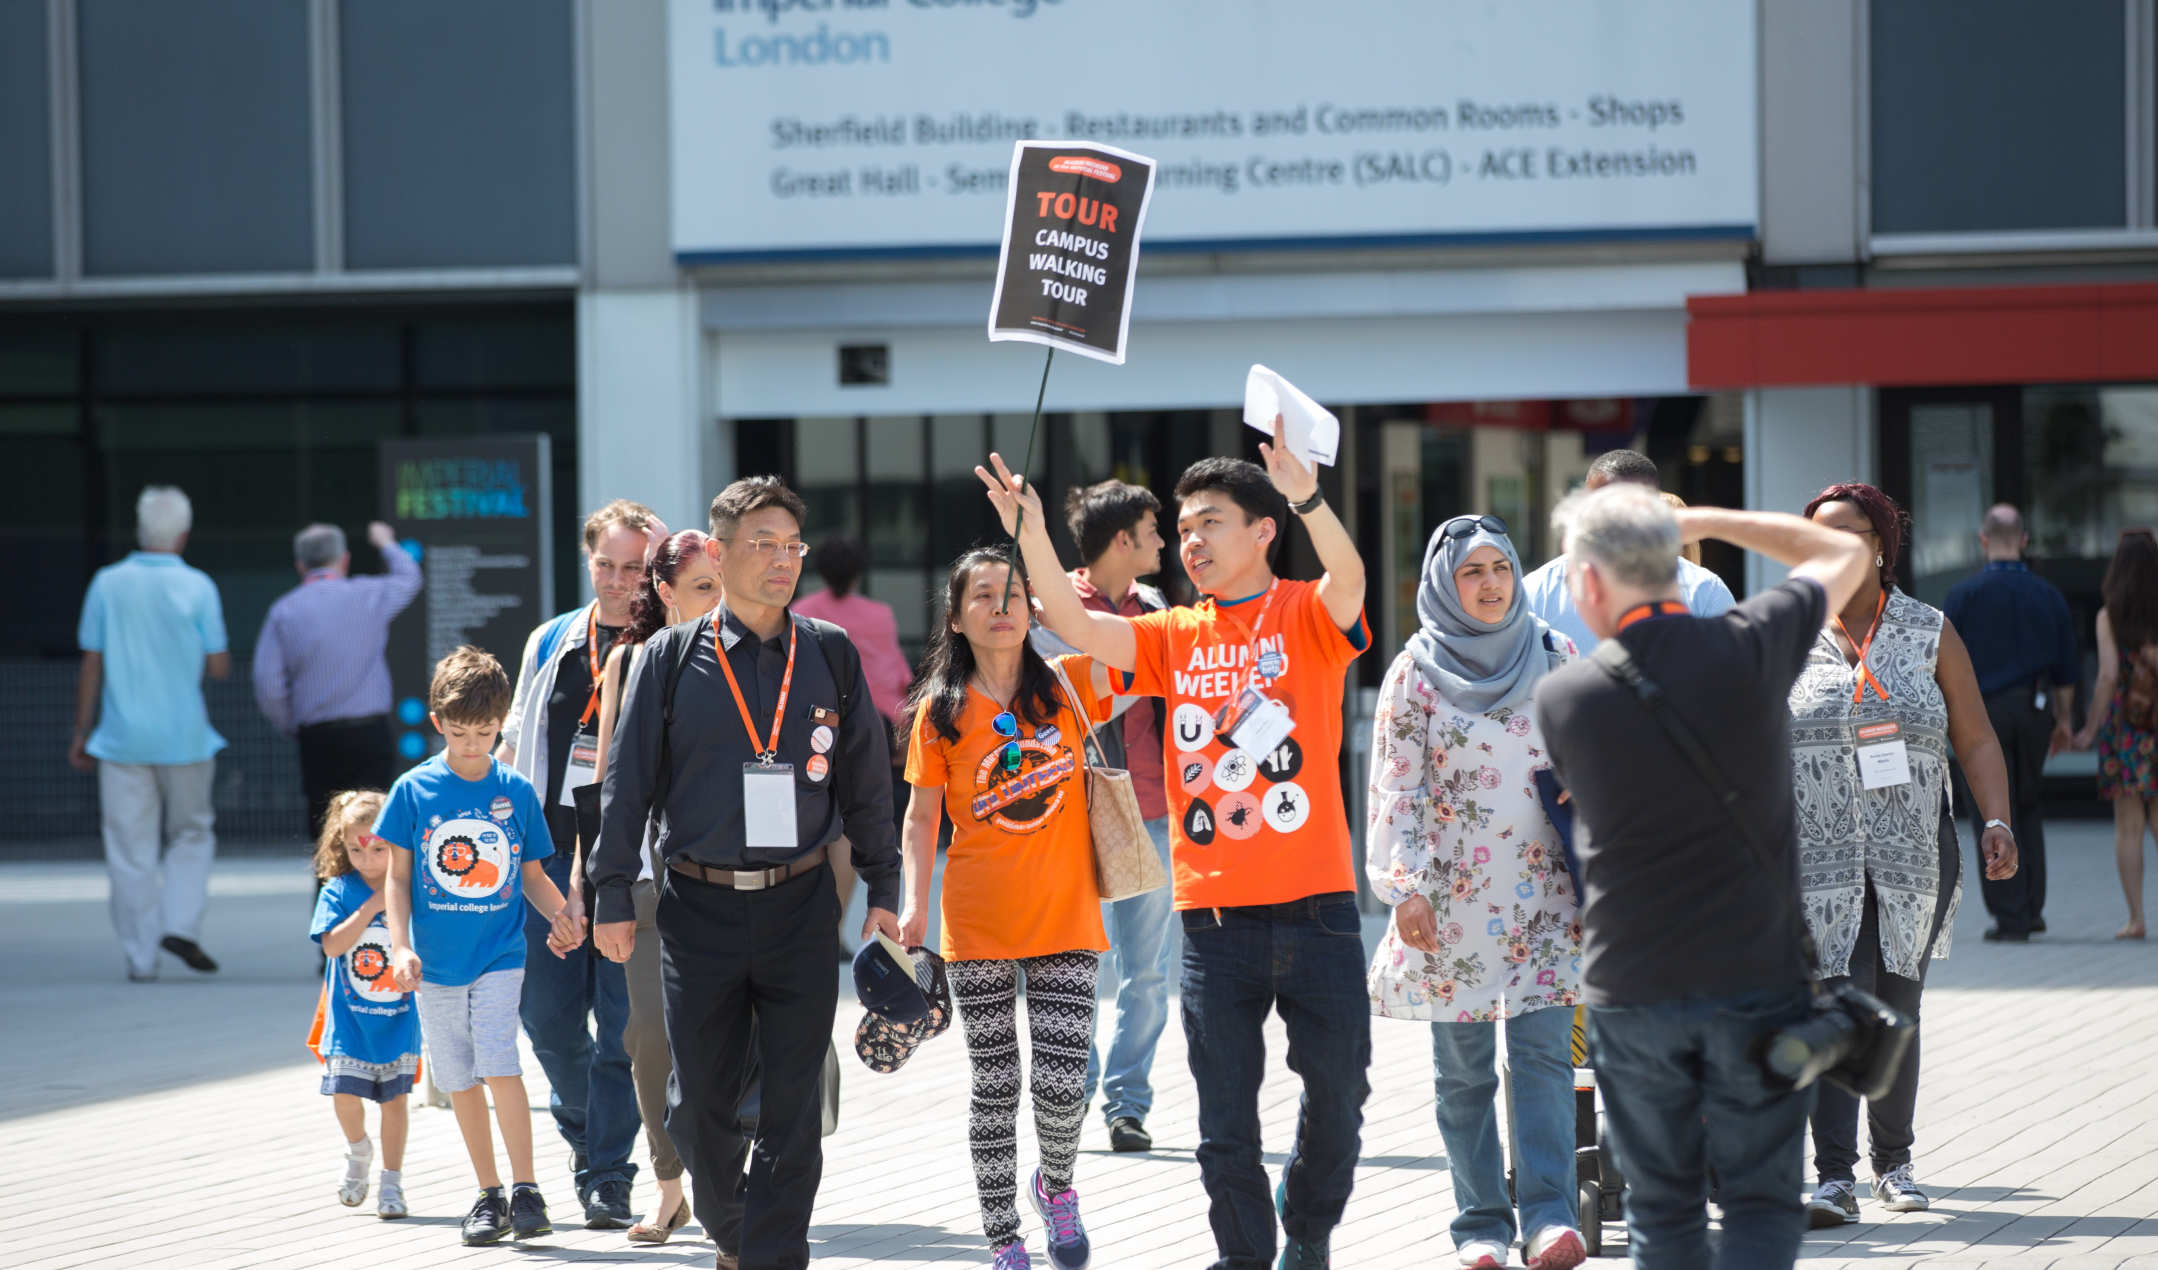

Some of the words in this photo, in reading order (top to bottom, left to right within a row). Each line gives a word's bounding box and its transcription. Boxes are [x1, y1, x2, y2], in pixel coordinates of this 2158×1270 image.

[713, 22, 890, 68] London
[770, 115, 906, 147] Sherfield
[913, 114, 1038, 144] Building
[1064, 108, 1243, 138] Restaurants
[1253, 104, 1308, 136] and
[1314, 102, 1449, 134] Common
[1457, 100, 1561, 131] Rooms
[1586, 95, 1685, 131] Shops
[770, 167, 851, 199] Great
[858, 164, 920, 196] Hall
[1246, 155, 1345, 188] Centre
[1352, 147, 1453, 188] (SALC)
[1478, 148, 1537, 182] ACE
[1546, 141, 1697, 179] Extension
[1036, 191, 1120, 233] TOUR
[1035, 228, 1110, 260] CAMPUS
[1029, 253, 1107, 286] WALKING
[1041, 279, 1088, 306] TOUR
